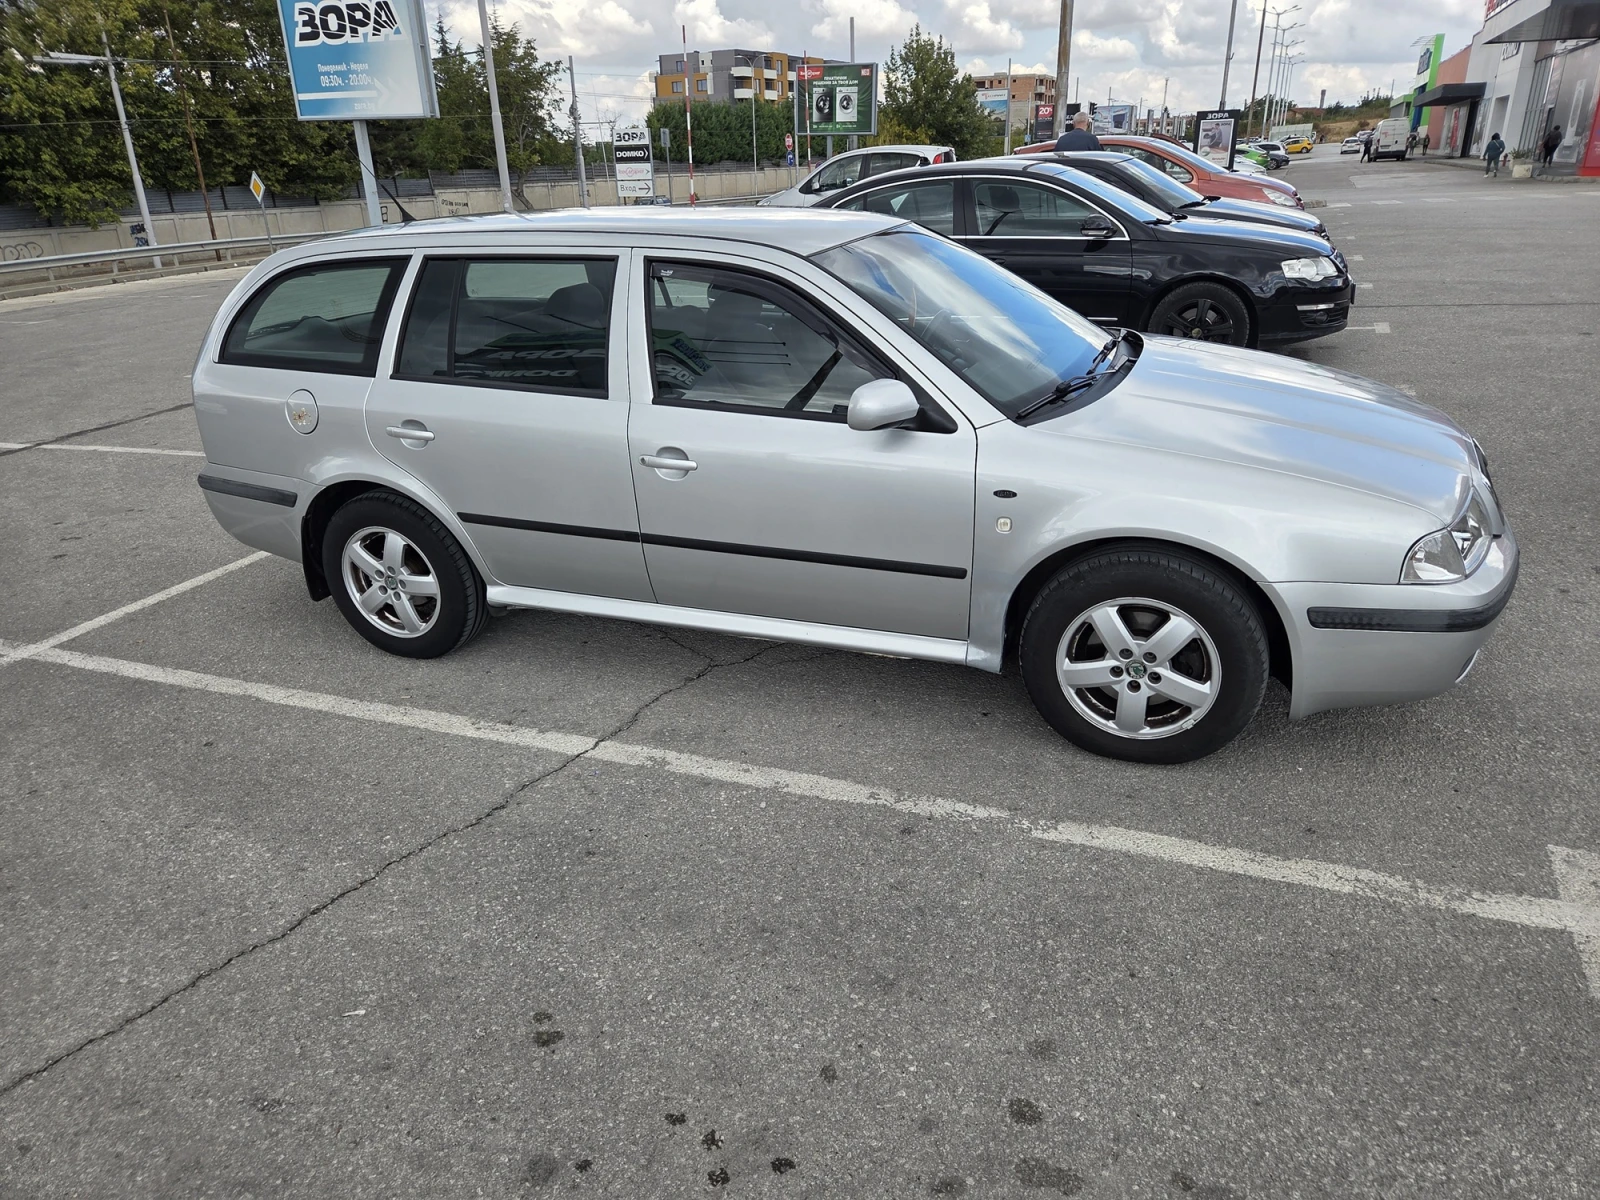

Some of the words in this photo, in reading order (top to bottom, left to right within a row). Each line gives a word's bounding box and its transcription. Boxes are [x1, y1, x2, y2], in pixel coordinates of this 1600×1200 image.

[295, 0, 407, 47] ЗОРА
[317, 62, 347, 72] Понеделник
[350, 62, 369, 72] Неделя
[320, 75, 345, 87] 09:30ч.
[348, 74, 374, 86] 20:00ч.
[1206, 112, 1229, 120] ЗОРА
[615, 131, 646, 142] ЗОРА
[616, 150, 644, 158] DOMKO
[620, 184, 637, 192] Вход
